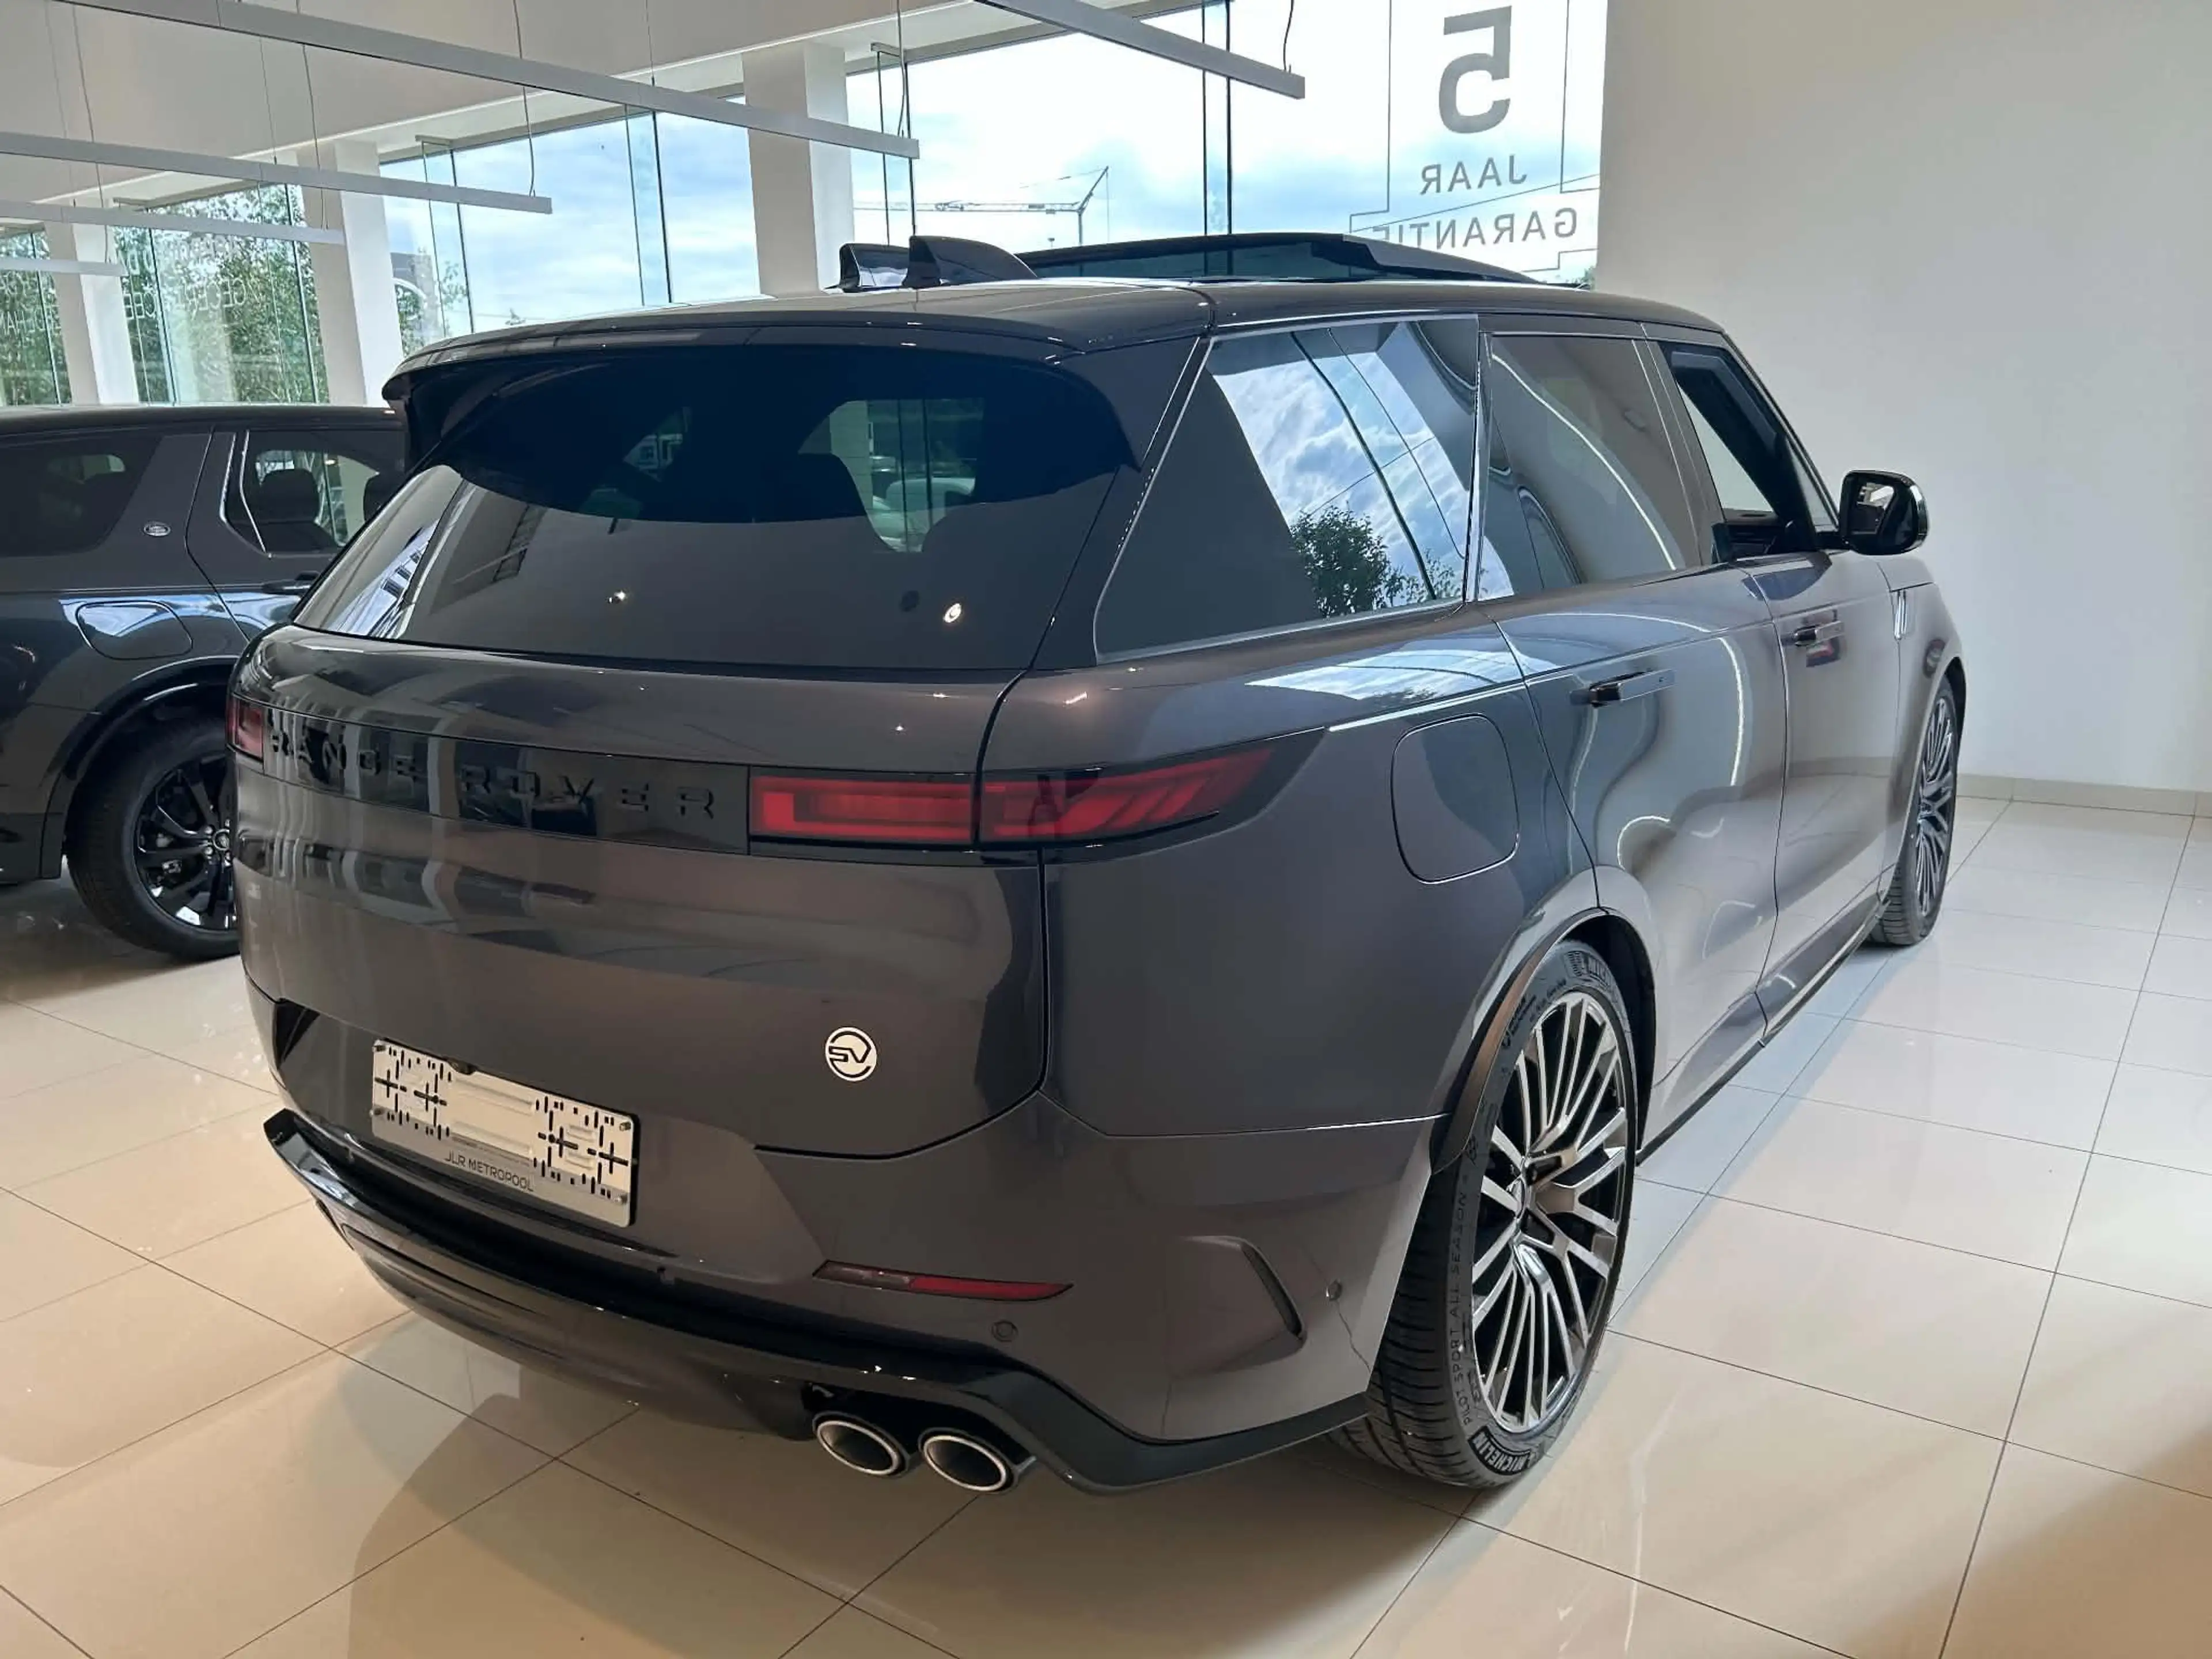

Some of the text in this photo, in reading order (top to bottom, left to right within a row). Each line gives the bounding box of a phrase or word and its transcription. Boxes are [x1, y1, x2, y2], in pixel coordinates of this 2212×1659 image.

[461, 764, 715, 820] ROVER
[444, 1149, 535, 1192] JLR METROPOOL
[1449, 1286, 1462, 1319] ALL
[1449, 1329, 1464, 1384] SPORT
[1472, 1431, 1530, 1472] MICHELIN
